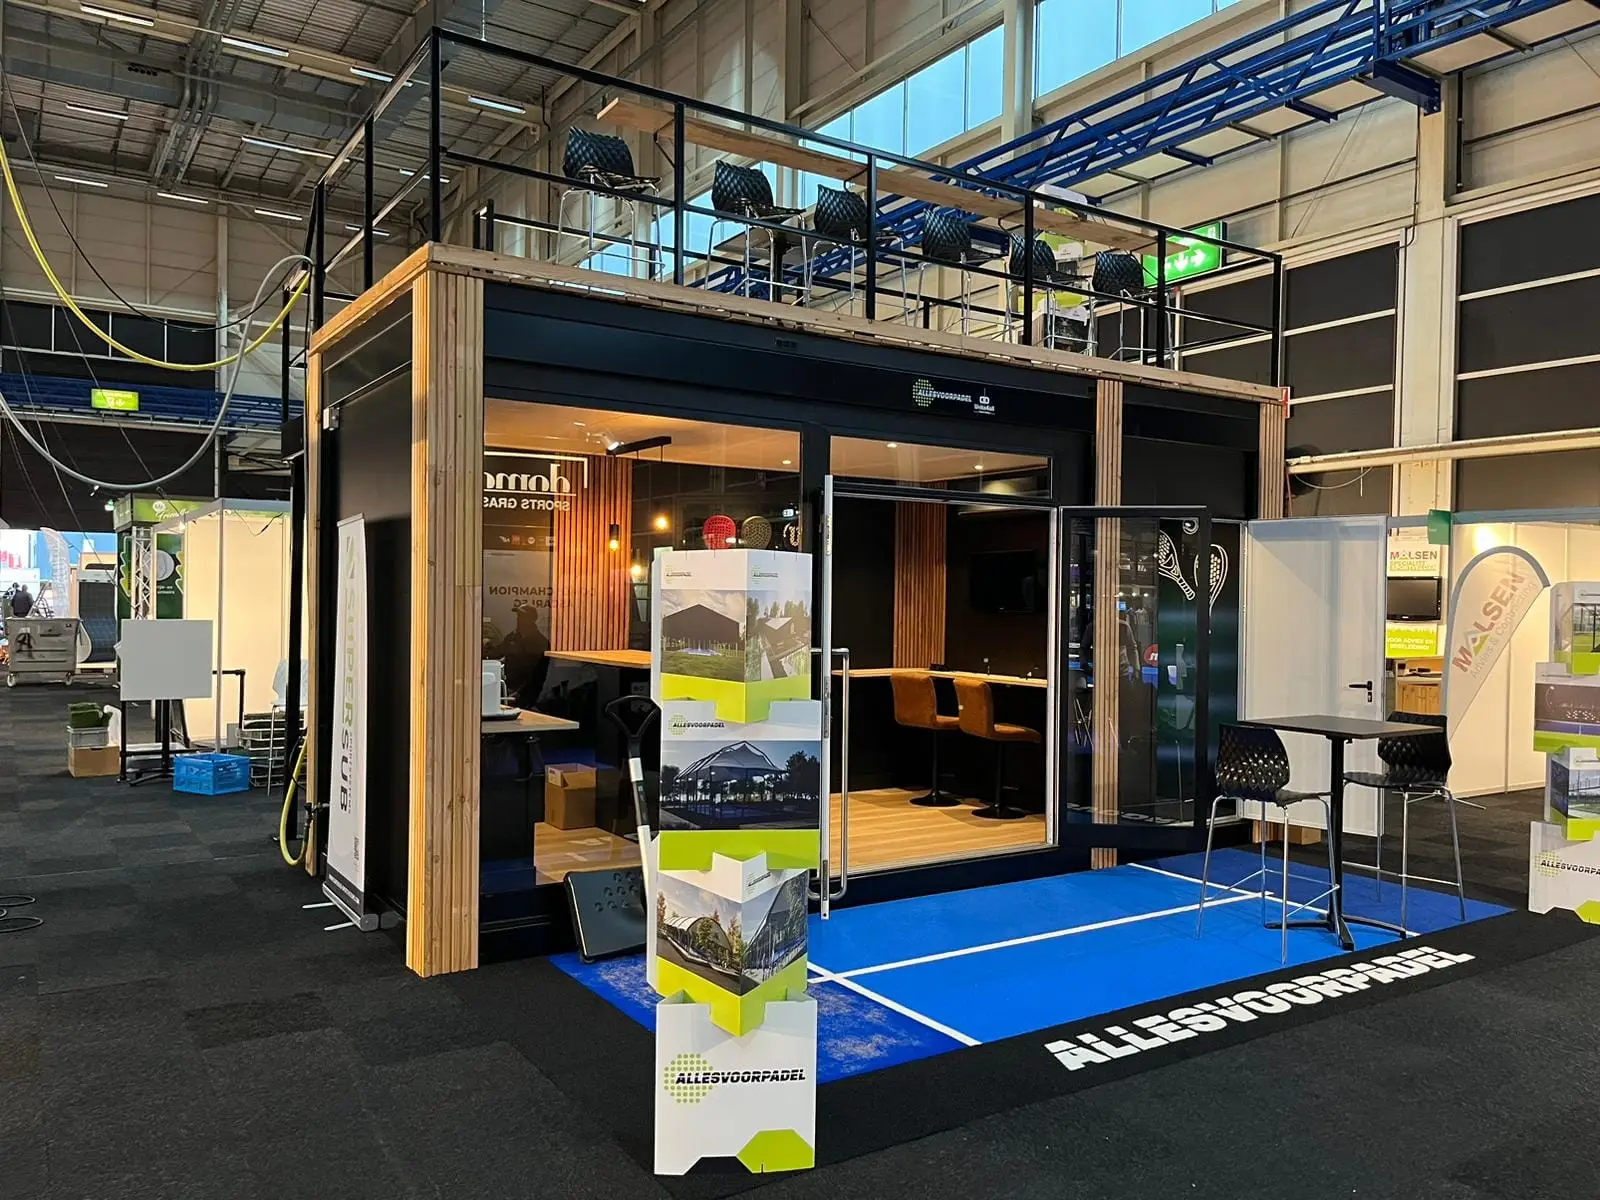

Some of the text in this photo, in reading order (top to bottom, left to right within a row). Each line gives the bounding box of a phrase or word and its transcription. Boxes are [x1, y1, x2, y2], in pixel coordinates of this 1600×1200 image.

[918, 389, 972, 402] ALLESVOORPADEL
[1452, 572, 1525, 673] MALSEN
[1044, 946, 1476, 1071] ALLESVOORPADEL
[676, 1069, 806, 1084] ALLESVOORPADEL
